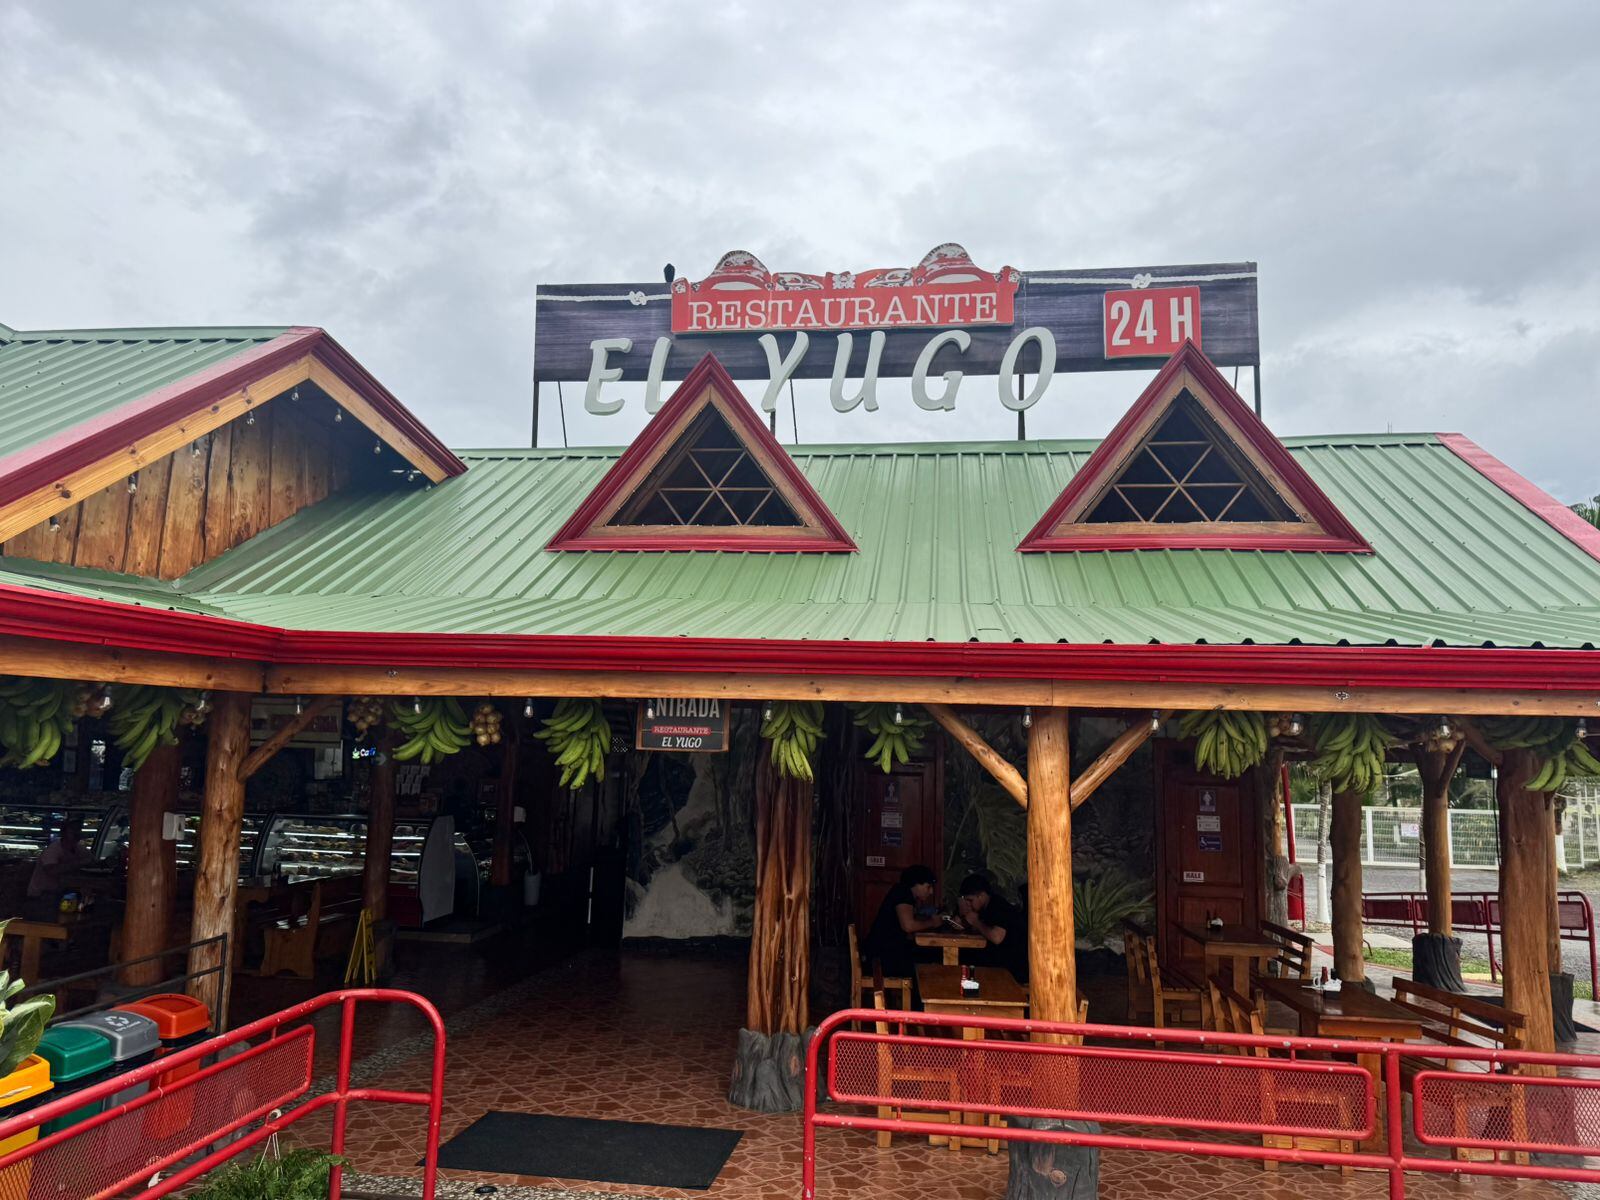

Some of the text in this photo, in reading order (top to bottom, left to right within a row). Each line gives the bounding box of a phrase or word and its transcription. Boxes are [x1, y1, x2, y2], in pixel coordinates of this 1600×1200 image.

[687, 292, 997, 330] RESTAURANTE
[1110, 296, 1193, 346] 24 H
[758, 326, 1057, 414] YUGO
[653, 725, 709, 735] RESTAURANTE
[661, 736, 702, 749] EL YUGO
